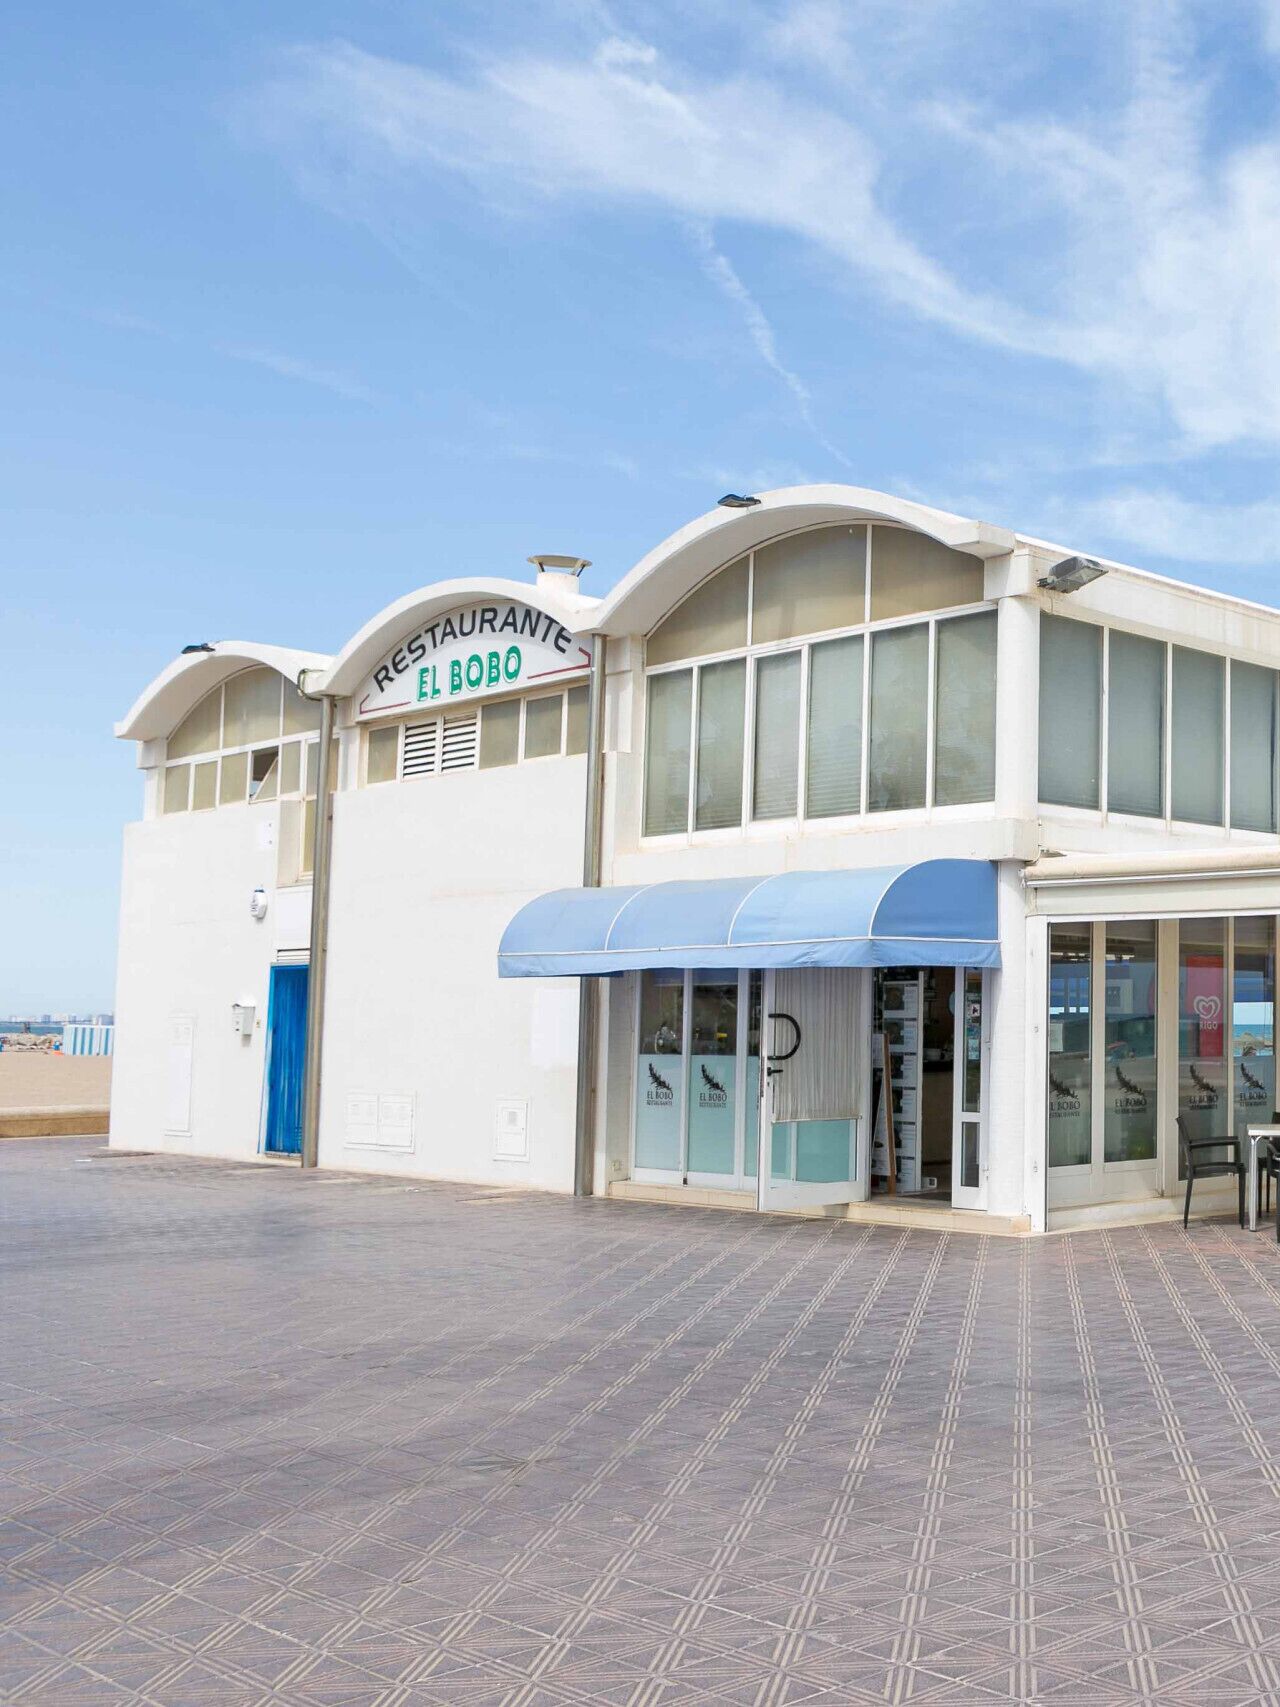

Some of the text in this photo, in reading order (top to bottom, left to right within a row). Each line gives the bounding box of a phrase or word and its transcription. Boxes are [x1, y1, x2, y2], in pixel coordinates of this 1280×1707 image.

[373, 606, 572, 693] RESTAURANTE
[417, 645, 522, 701] EL BOBO
[655, 1090, 674, 1100] BOBO
[708, 1092, 728, 1103] BOBO
